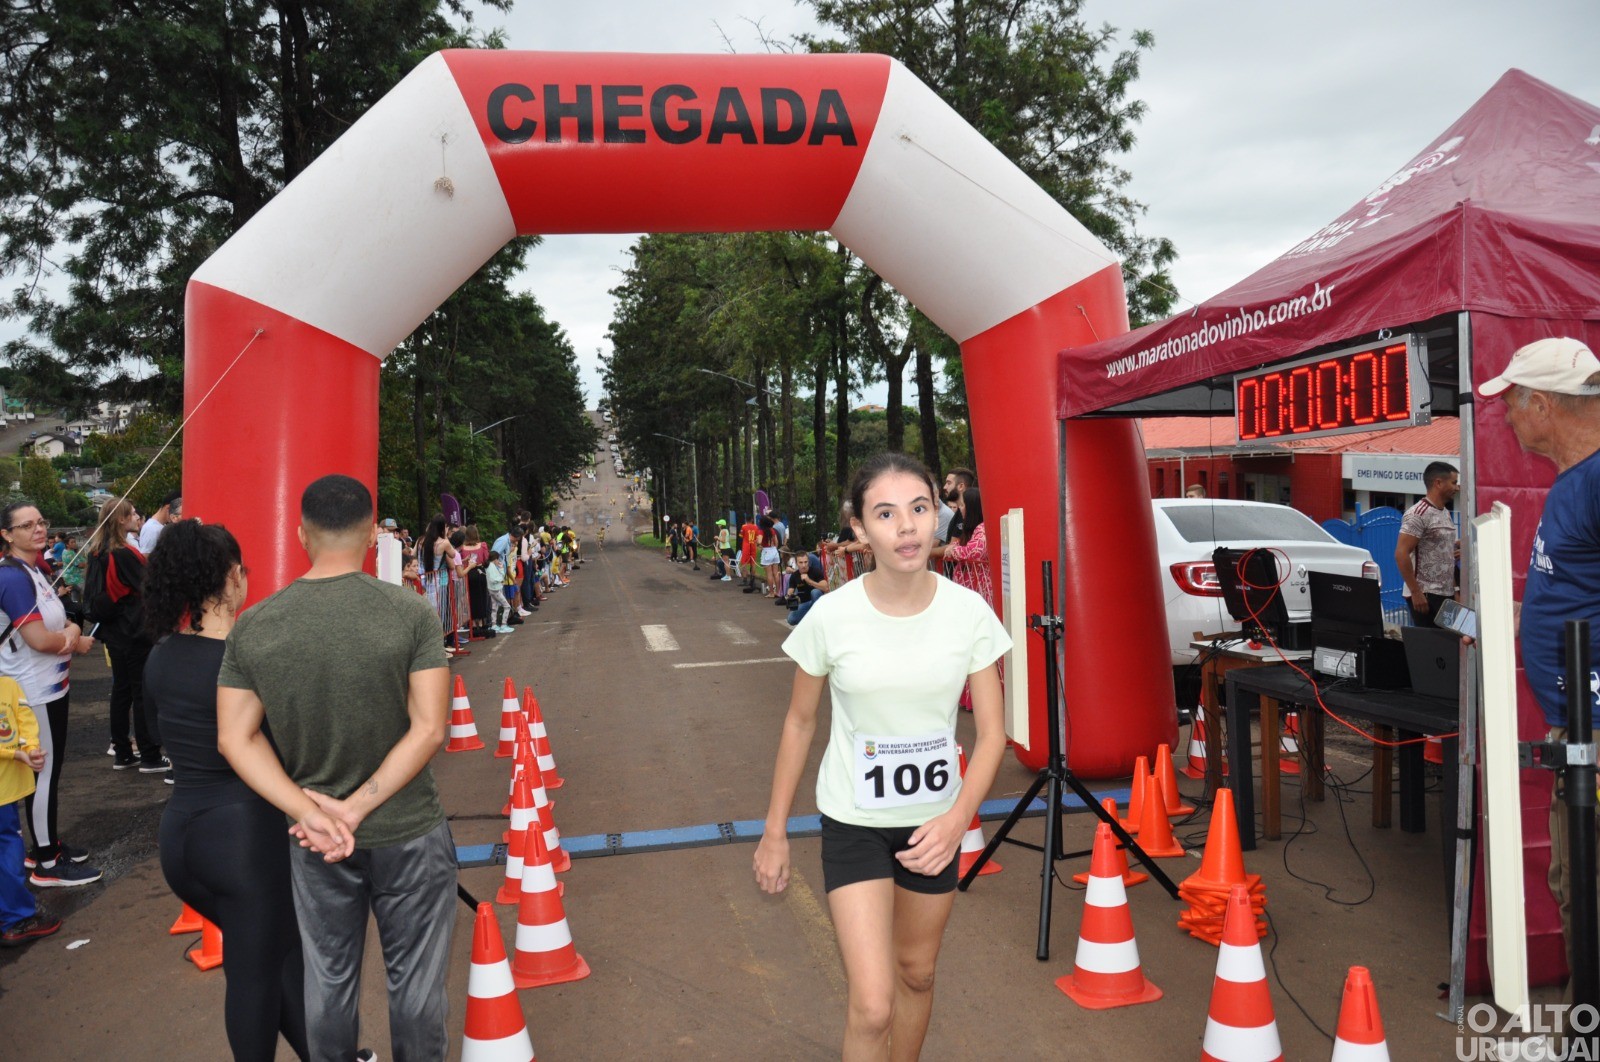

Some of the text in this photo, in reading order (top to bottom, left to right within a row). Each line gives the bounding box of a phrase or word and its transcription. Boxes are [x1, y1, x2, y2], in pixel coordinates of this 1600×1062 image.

[486, 83, 858, 146] CHEGADA
[1106, 282, 1334, 378] www.maratonadovinho.com.br
[1240, 345, 1410, 440] 00:00:00
[1357, 469, 1424, 481] EMEI PINGO DE GENT
[912, 737, 947, 748] INTERESTADUAL
[924, 741, 948, 751] ALPESTRE
[865, 759, 949, 798] 106
